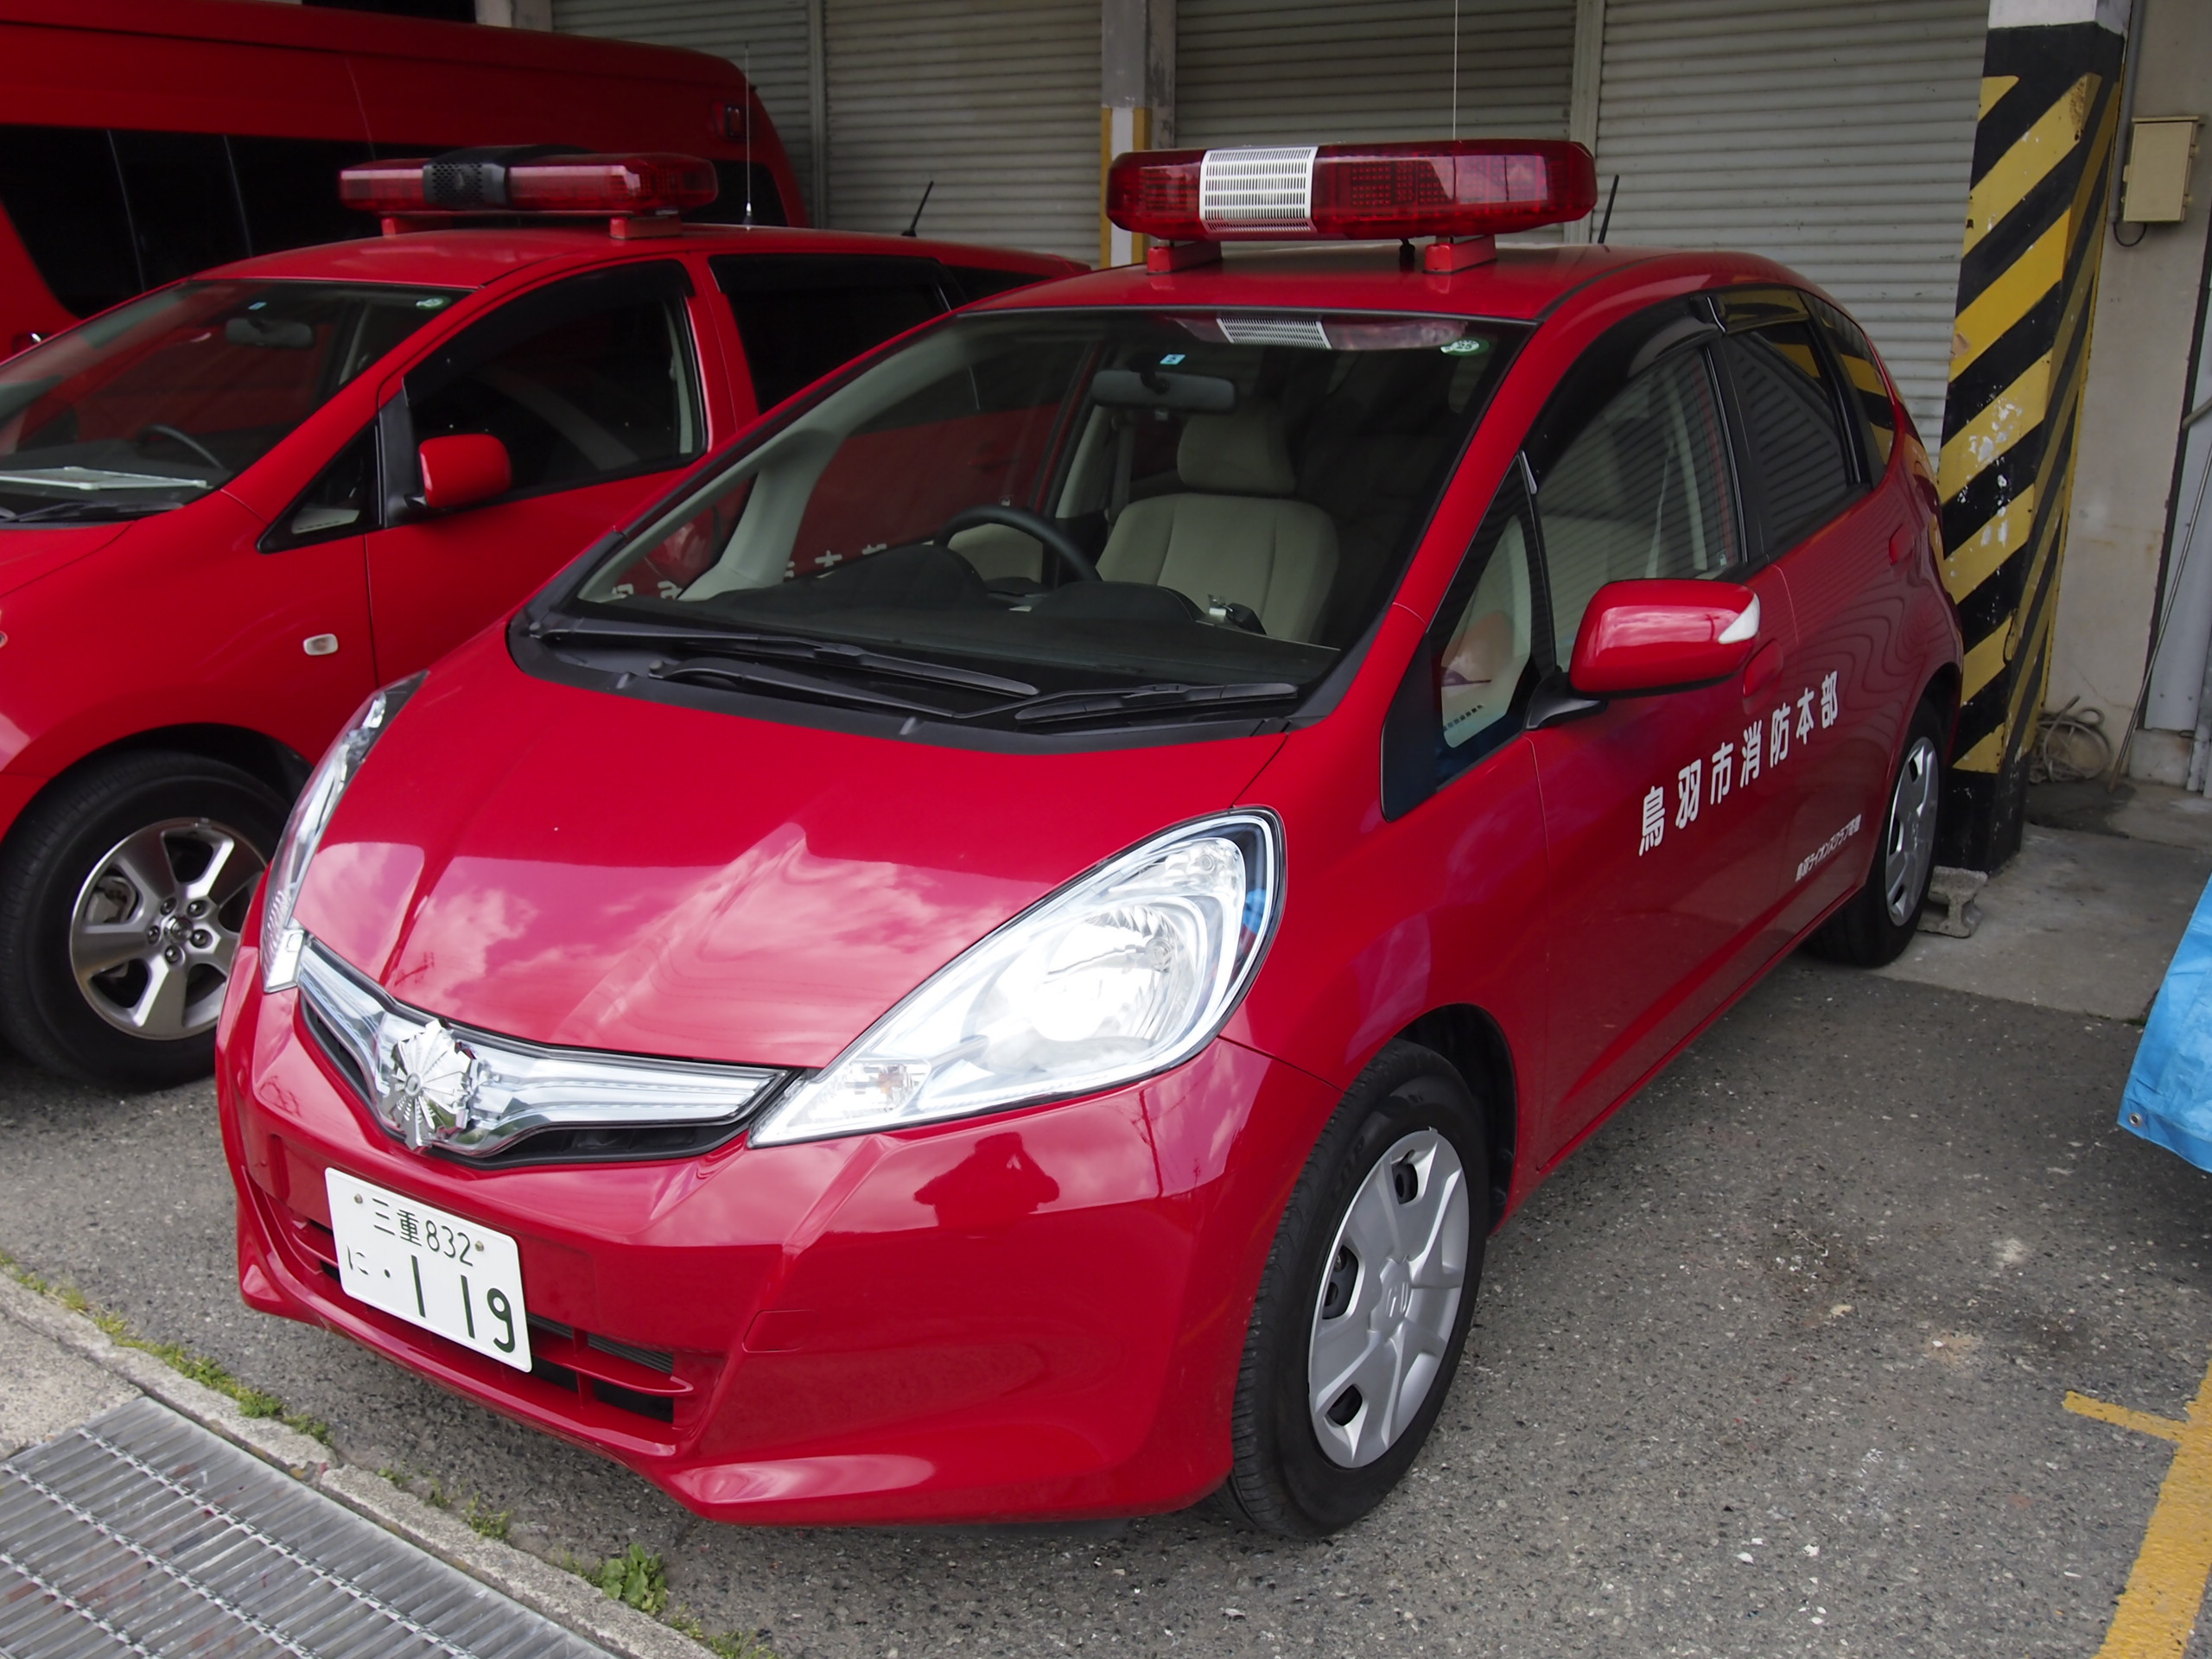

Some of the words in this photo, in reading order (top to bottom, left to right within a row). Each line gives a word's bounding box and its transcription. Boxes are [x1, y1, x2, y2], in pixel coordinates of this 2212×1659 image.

[1638, 670, 1838, 856] 鳥羽市消防本部
